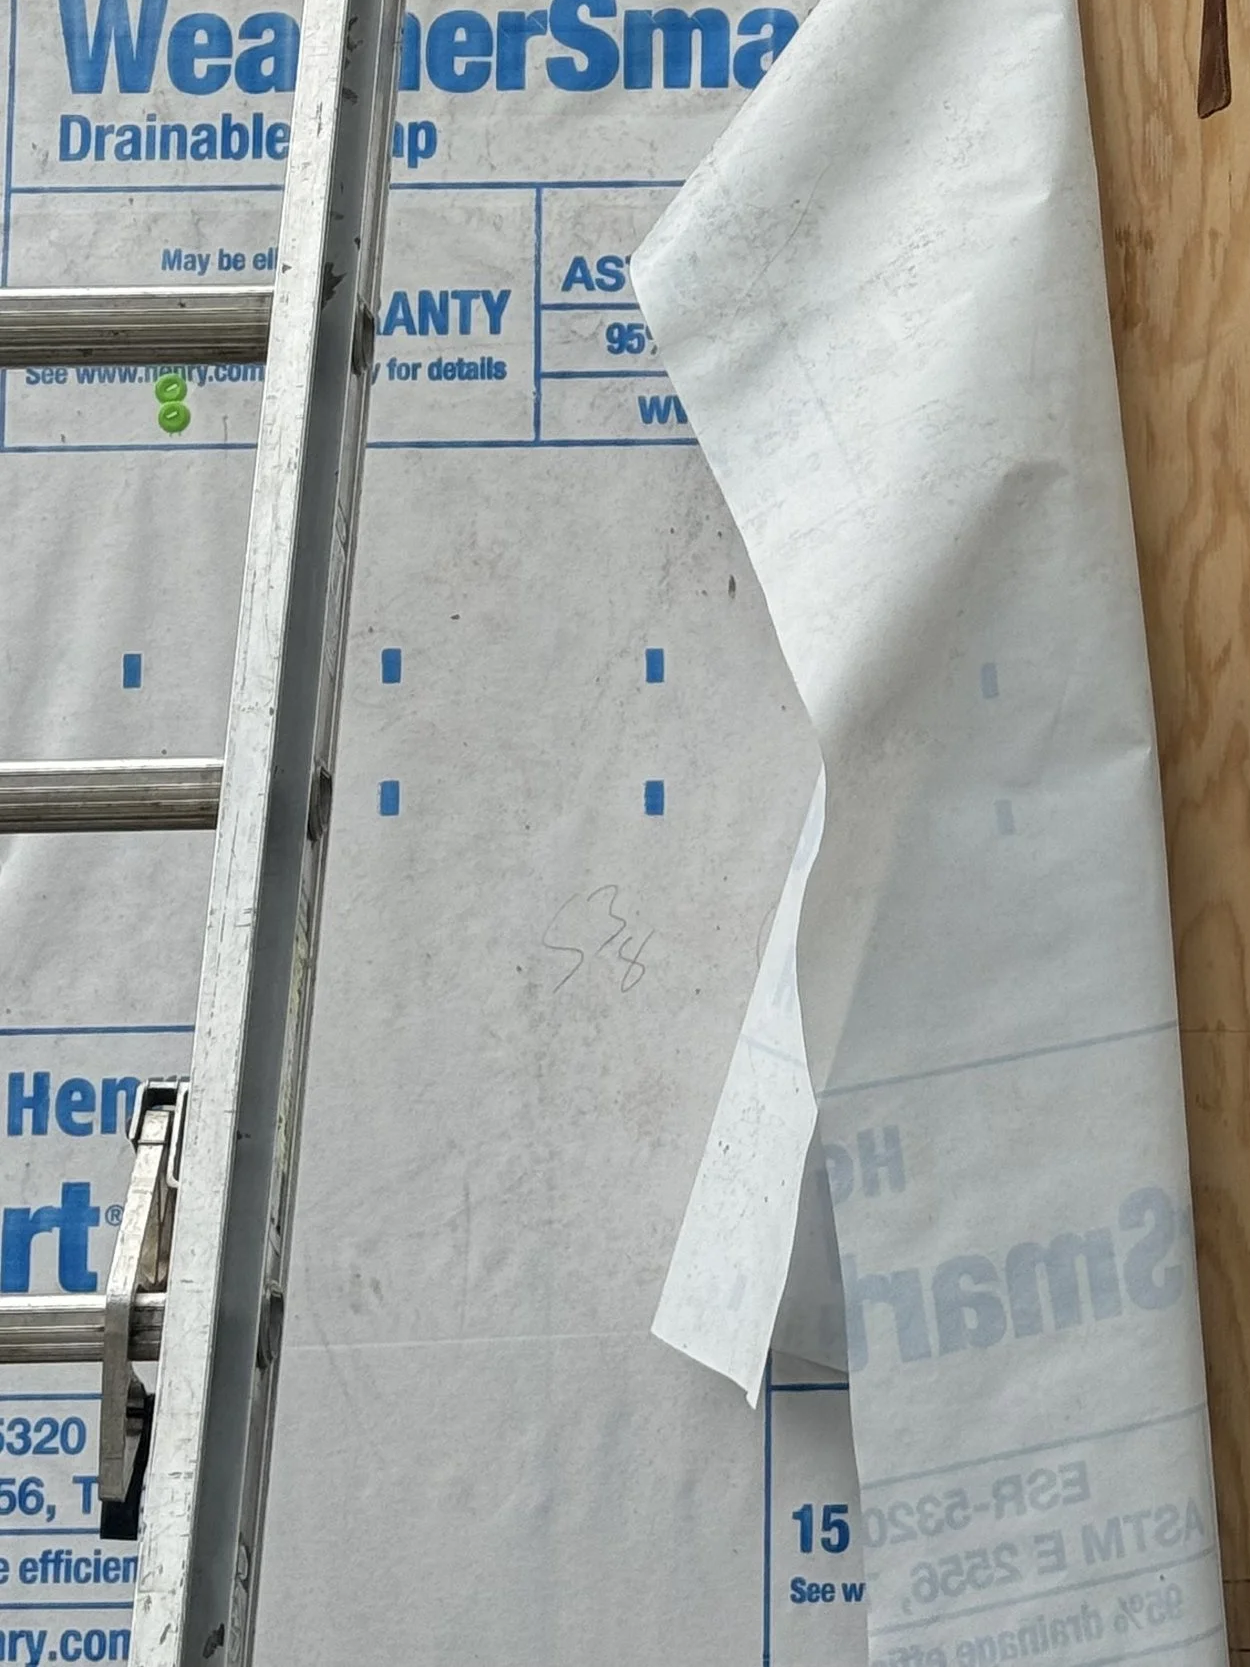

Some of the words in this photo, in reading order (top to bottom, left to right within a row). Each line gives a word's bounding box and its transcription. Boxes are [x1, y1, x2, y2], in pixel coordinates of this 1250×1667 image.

[59, 112, 290, 162] Drainable
[161, 248, 211, 276] May
[218, 248, 246, 271] be
[561, 254, 632, 292] AS
[376, 289, 511, 336] ANTY
[387, 357, 421, 381] for
[428, 356, 507, 381] details
[0, 1416, 87, 1455] 320
[792, 1502, 850, 1554] 15
[790, 1575, 836, 1604] See
